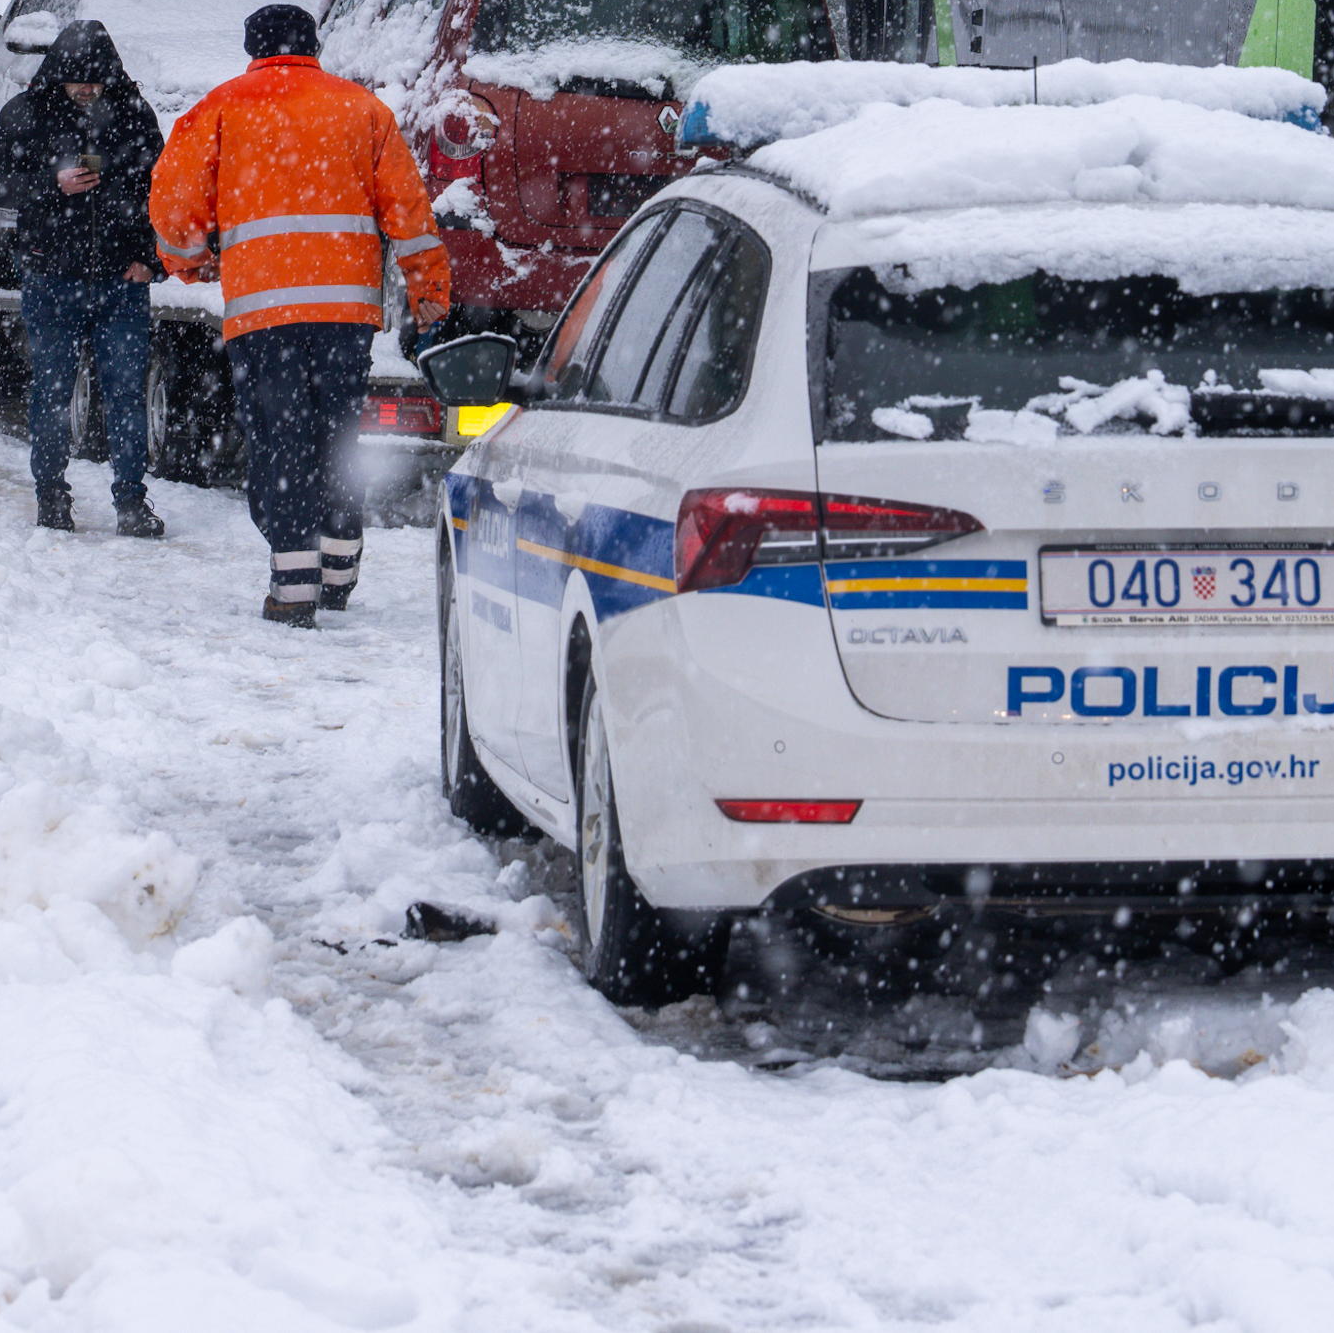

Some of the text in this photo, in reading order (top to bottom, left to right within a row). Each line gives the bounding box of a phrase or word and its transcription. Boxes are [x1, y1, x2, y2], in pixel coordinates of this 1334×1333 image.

[1088, 557, 1321, 608] 040 340
[1193, 614, 1220, 623] ZADAR,
[1223, 614, 1252, 624] Kijevska
[848, 627, 969, 644] OCTAVIA
[1109, 754, 1320, 787] policija.gov.hr
